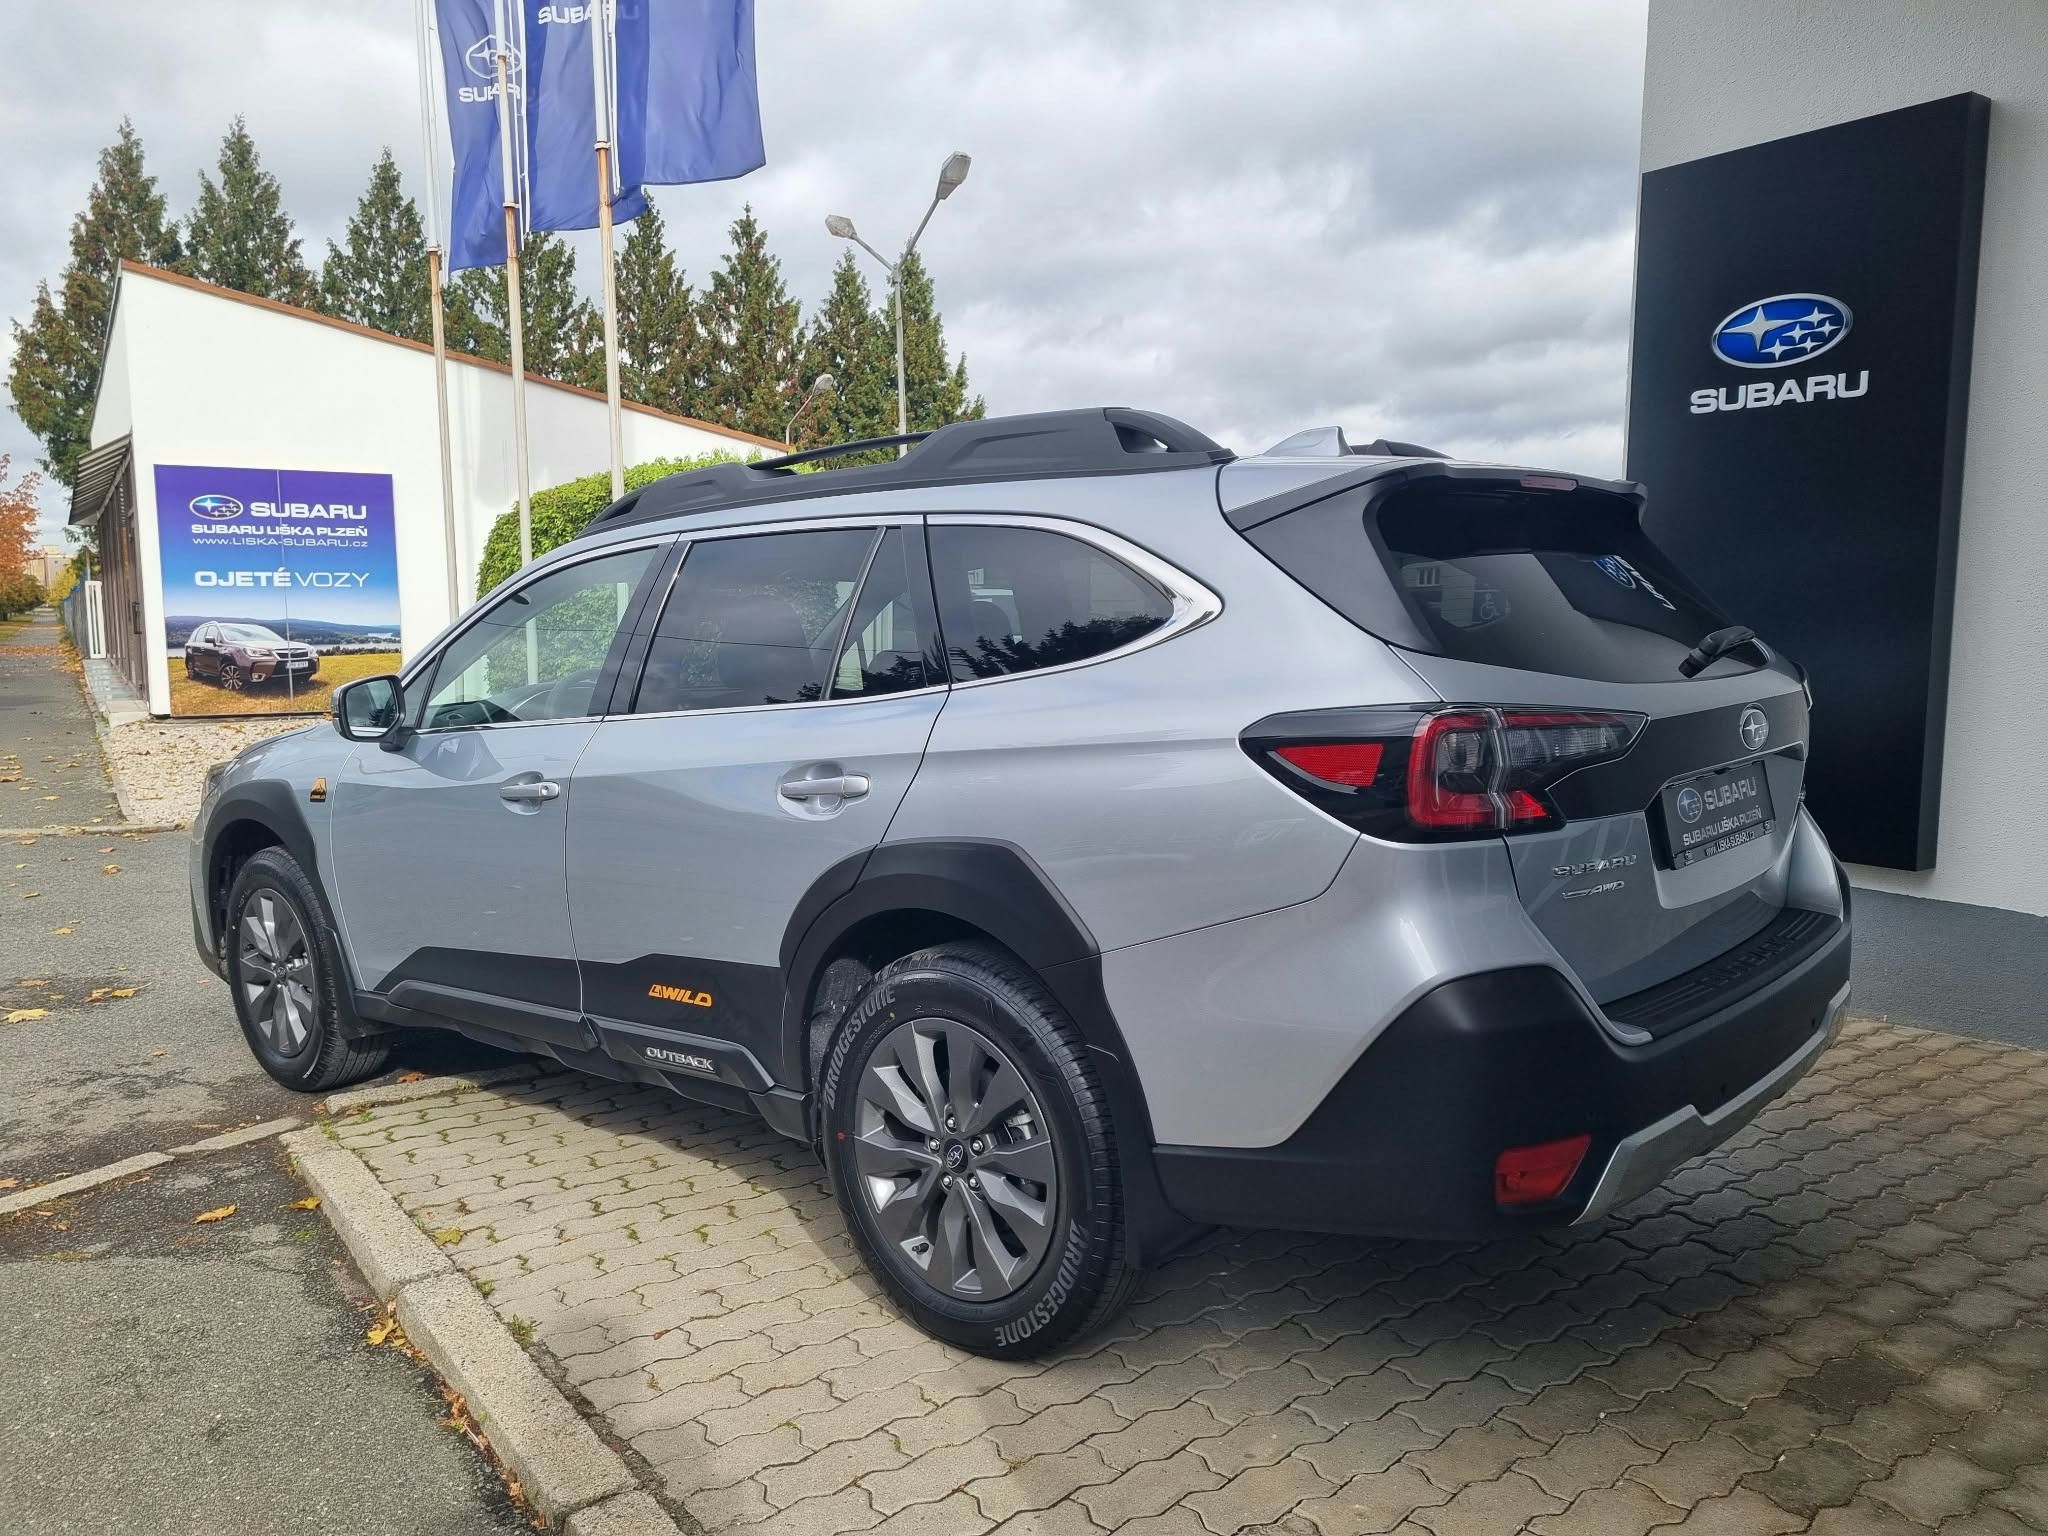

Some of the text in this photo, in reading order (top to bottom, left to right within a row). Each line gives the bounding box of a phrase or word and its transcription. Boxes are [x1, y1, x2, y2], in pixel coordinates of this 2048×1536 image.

[538, 4, 639, 24] SUBAU
[1690, 370, 1869, 414] SUBARU
[250, 502, 367, 520] SUBARU
[191, 523, 368, 537] SUBARU LIŠKA PLZEŇ
[192, 537, 369, 548] www.LISKA-SUBARU.cz
[194, 567, 370, 588] OJETÉ VOZY
[1704, 776, 1757, 811] SUBARU
[1683, 805, 1763, 846] SUBARU LIŠKA PLZEŇ
[1553, 854, 1637, 877] SUBARU
[645, 1046, 714, 1071] OUTBACK
[823, 986, 896, 1111] BRIDGESTONE
[993, 1217, 1088, 1348] BRIDGESTONE
